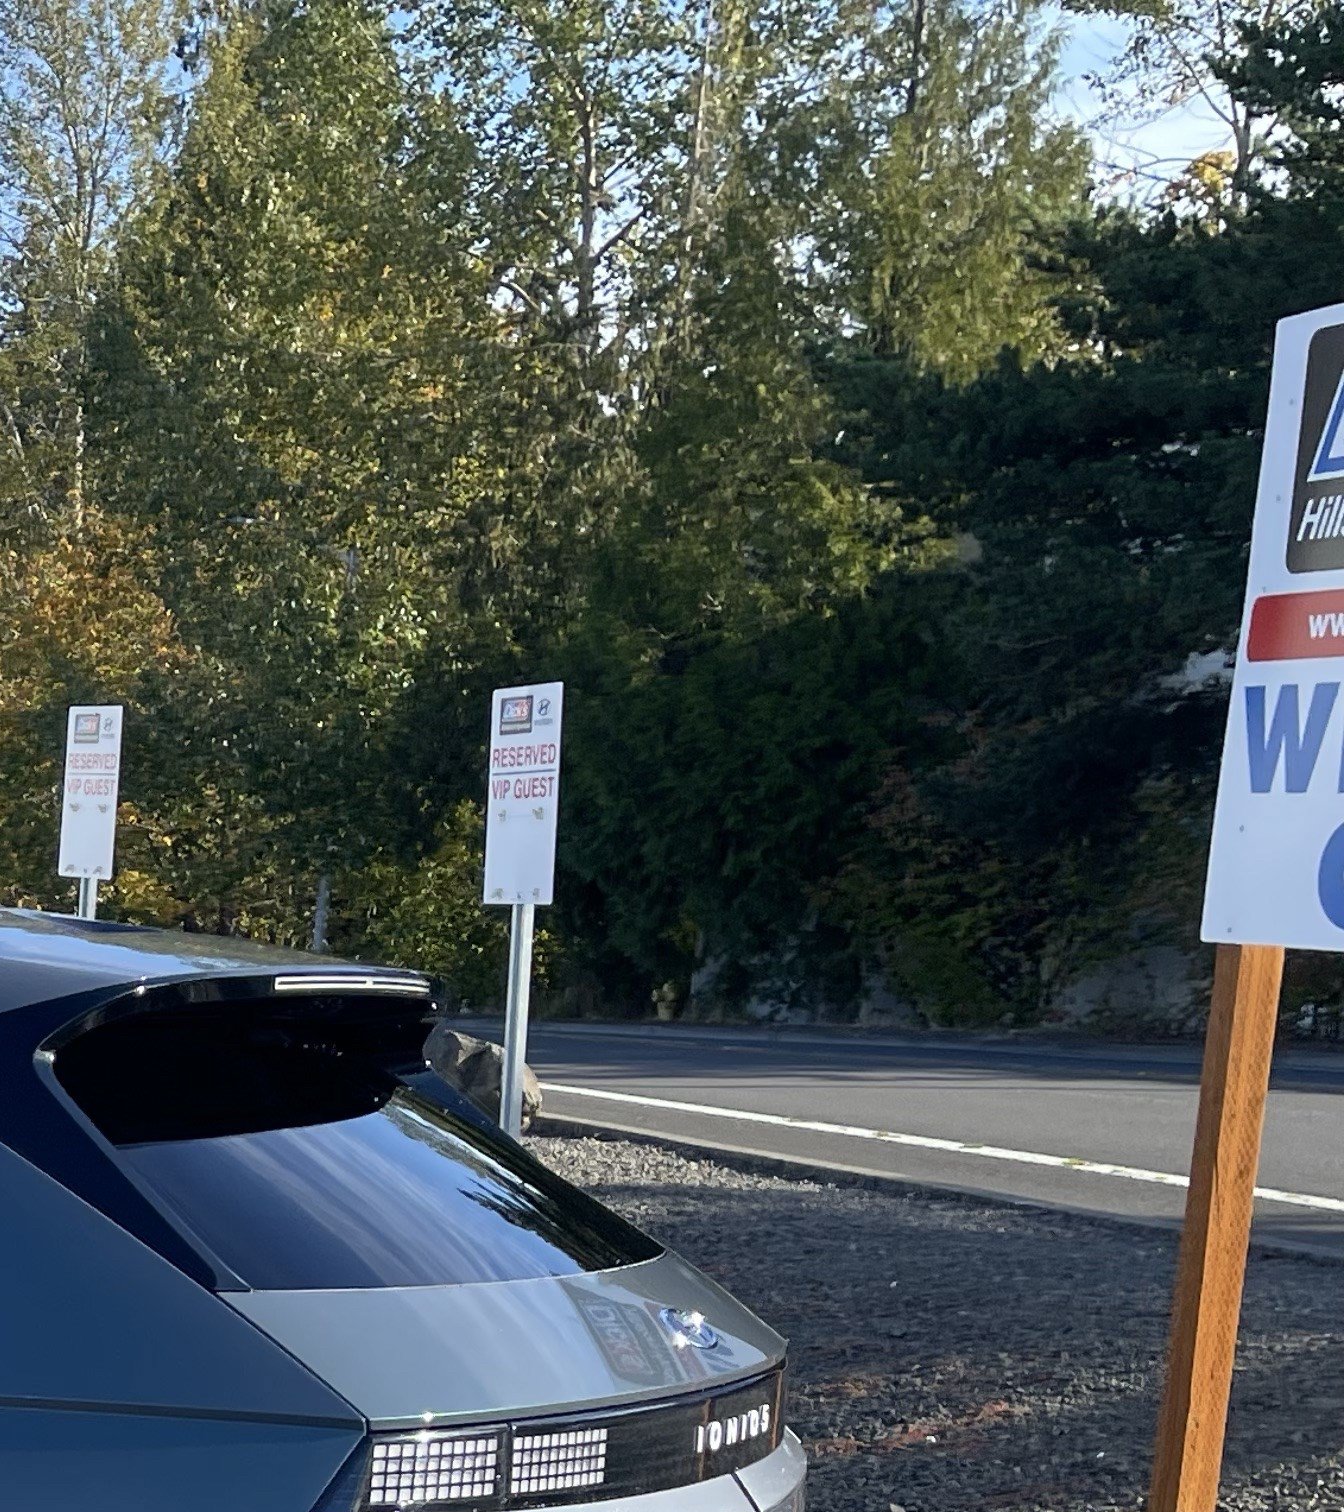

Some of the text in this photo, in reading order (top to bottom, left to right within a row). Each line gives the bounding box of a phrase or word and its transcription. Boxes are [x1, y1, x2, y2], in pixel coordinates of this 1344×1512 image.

[1296, 494, 1344, 541] Hill
[1245, 681, 1344, 794] W
[68, 752, 118, 770] RESERVED
[492, 743, 556, 768] RESERVED
[84, 778, 116, 796] GUEST
[492, 777, 555, 800] VIP GUEST
